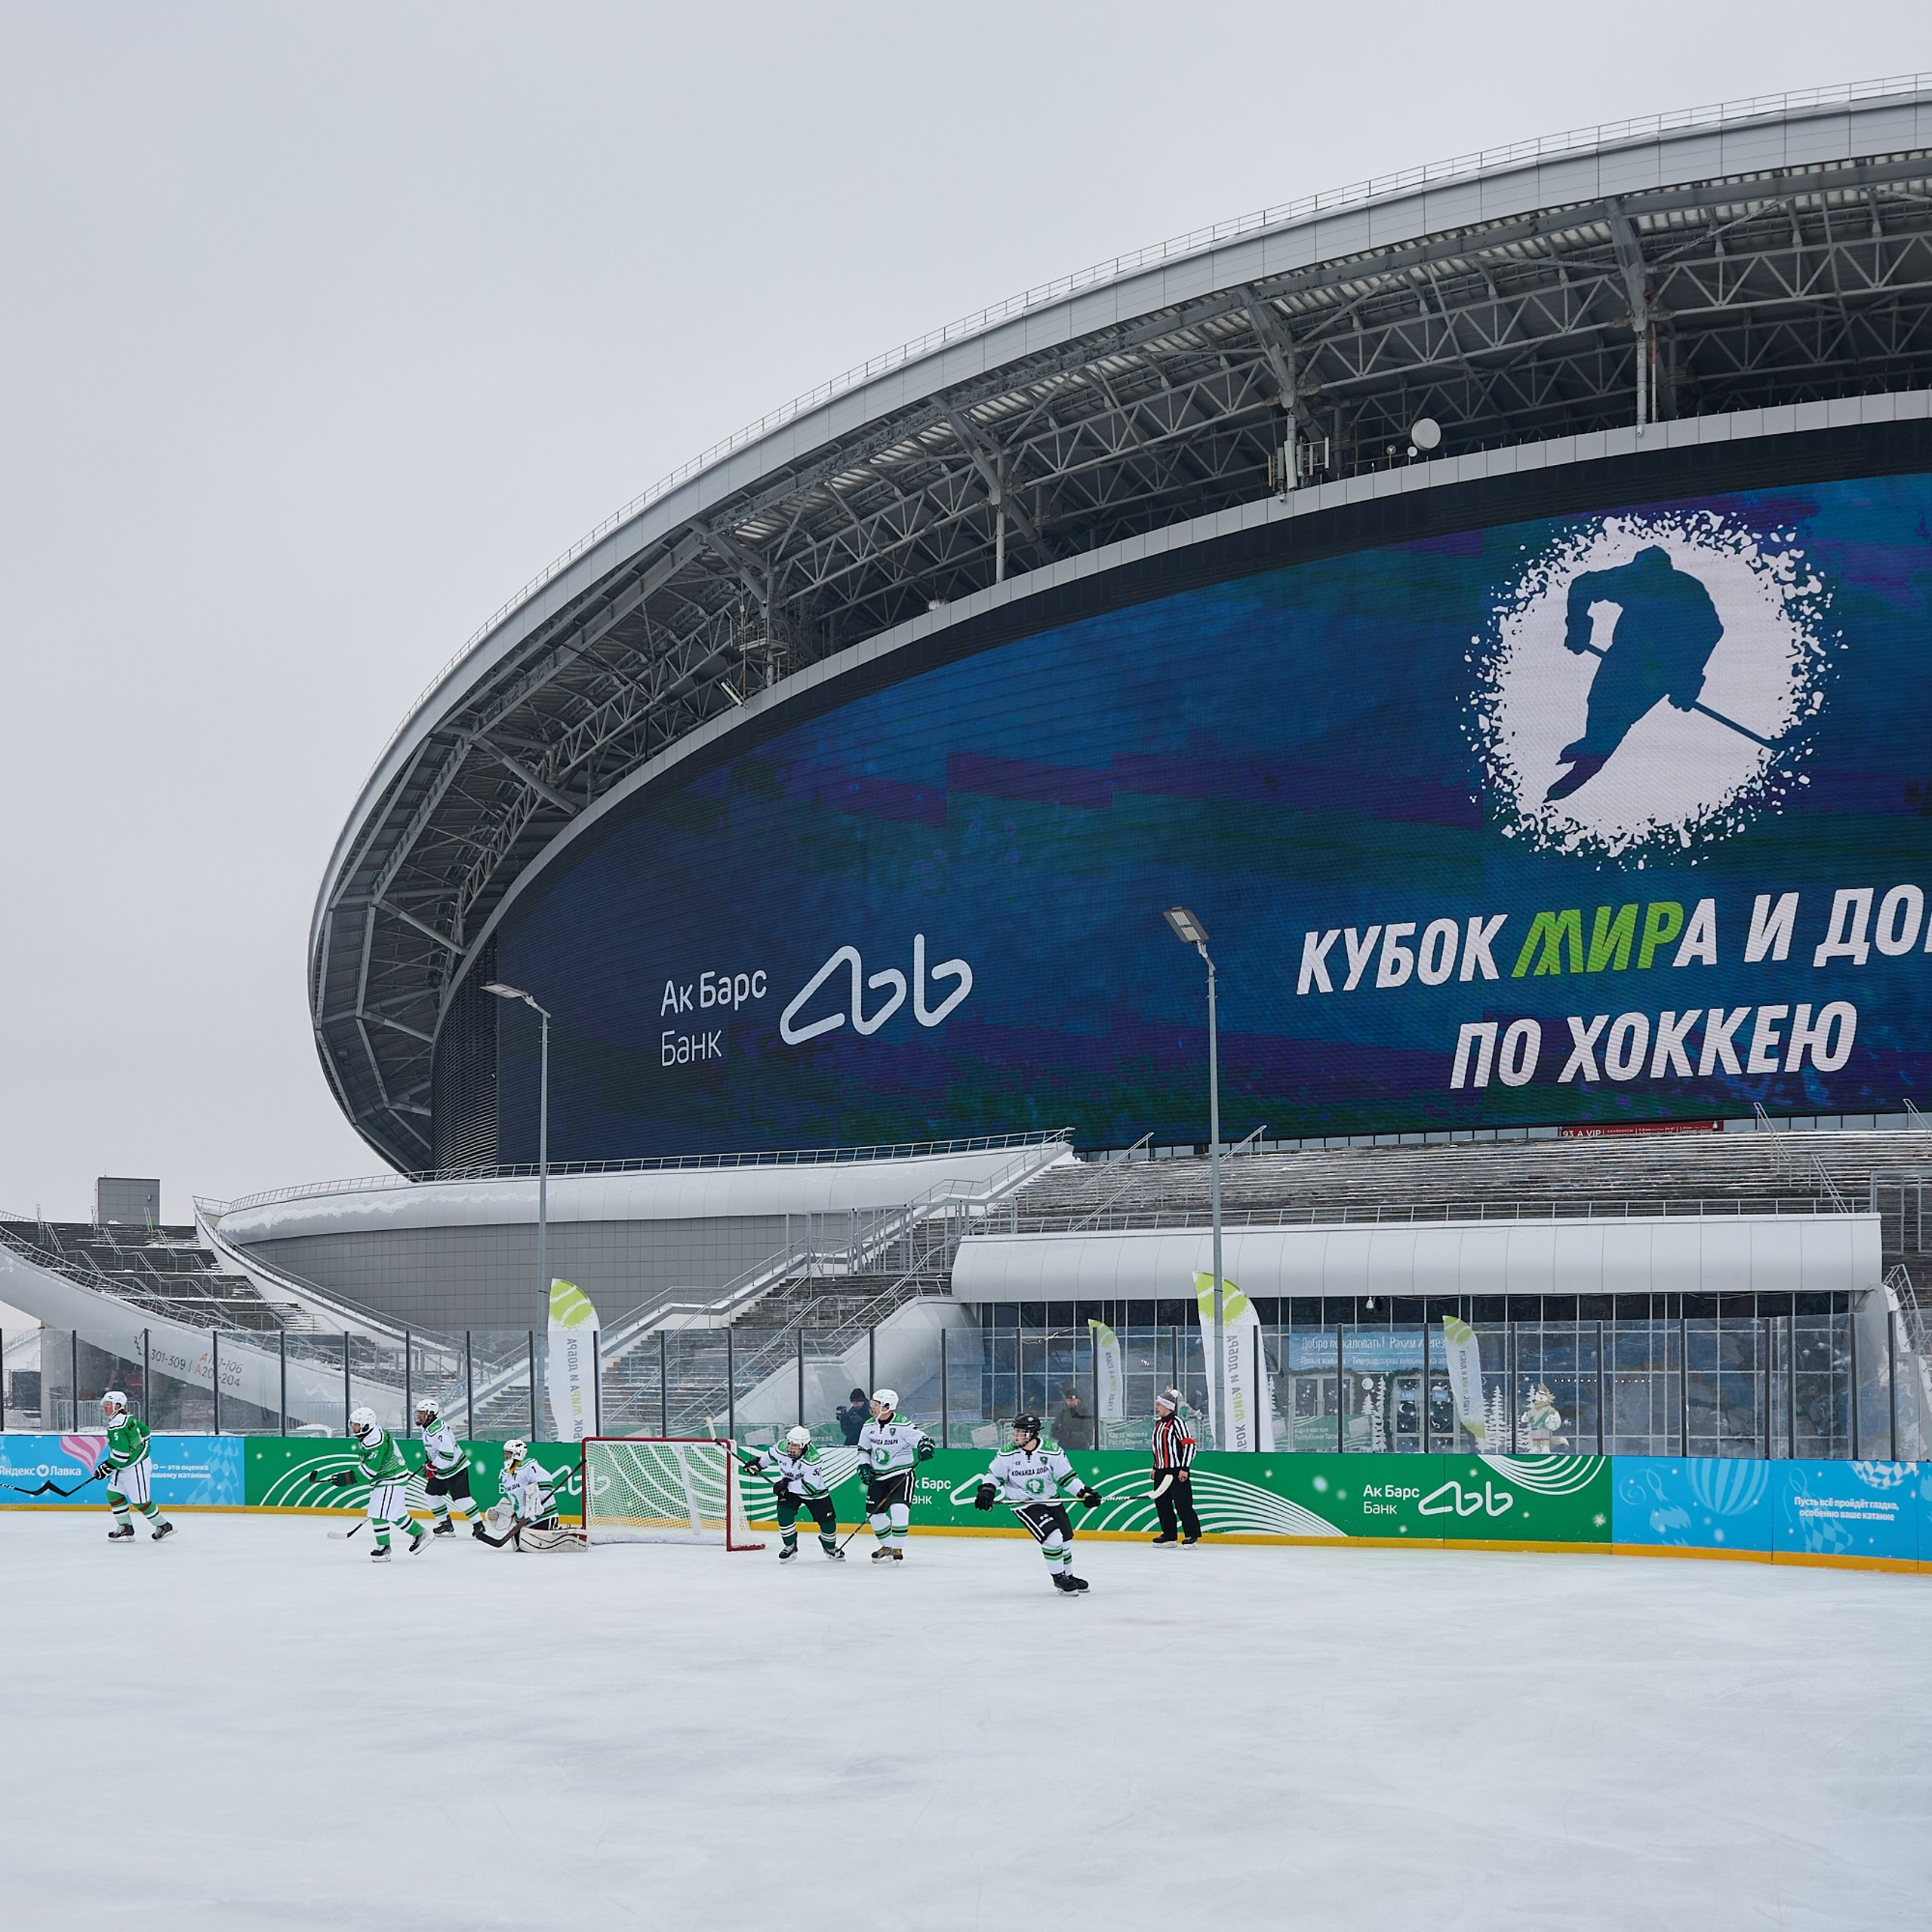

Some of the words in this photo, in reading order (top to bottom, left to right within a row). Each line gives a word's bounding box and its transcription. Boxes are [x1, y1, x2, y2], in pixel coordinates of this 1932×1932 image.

[1295, 913, 1508, 995] КУБОК
[1511, 898, 1718, 978] МИРА
[1743, 891, 1800, 963] И
[1813, 884, 1932, 968] ДО
[660, 980, 694, 1017] Ак
[700, 969, 768, 1011] Барс
[660, 1030, 722, 1067] Банк
[1450, 1018, 1542, 1091] ПО
[1557, 1000, 1858, 1084] ХОККЕЮ
[1301, 1337, 1328, 1351] Добро
[199, 1352, 244, 1374] A11-106
[194, 1364, 241, 1387] A20-204
[0, 1466, 35, 1477] Яндекс
[50, 1466, 82, 1476] Лавка
[921, 1477, 952, 1492] Барс
[1363, 1484, 1382, 1497] Ак
[1385, 1484, 1420, 1500] Барс
[912, 1495, 932, 1505] анк
[1794, 1497, 1819, 1507] Пусть
[1820, 1497, 1834, 1507] всё
[1835, 1498, 1869, 1509] пройдёт
[1869, 1500, 1900, 1512] гладко,
[1363, 1502, 1398, 1515] Банк
[1799, 1508, 1839, 1518] особенно
[1840, 1511, 1862, 1519] ваше
[1863, 1512, 1895, 1521] катание
